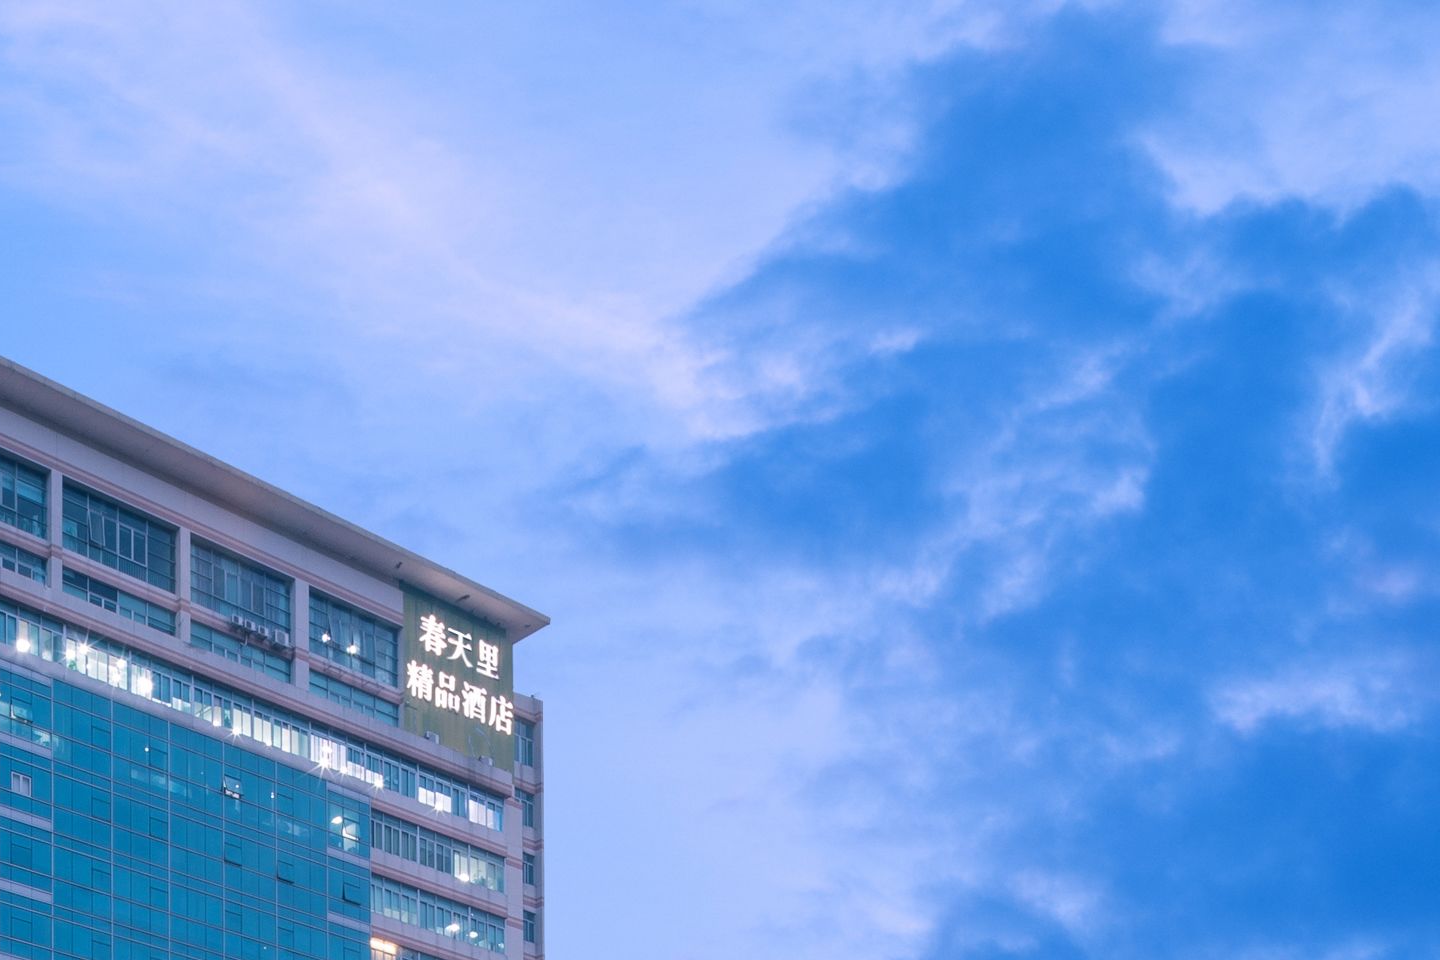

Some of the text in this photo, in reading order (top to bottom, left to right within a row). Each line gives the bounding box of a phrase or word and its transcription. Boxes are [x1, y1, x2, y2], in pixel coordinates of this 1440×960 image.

[419, 614, 500, 680] 春天里
[406, 660, 514, 735] 精品酒店
